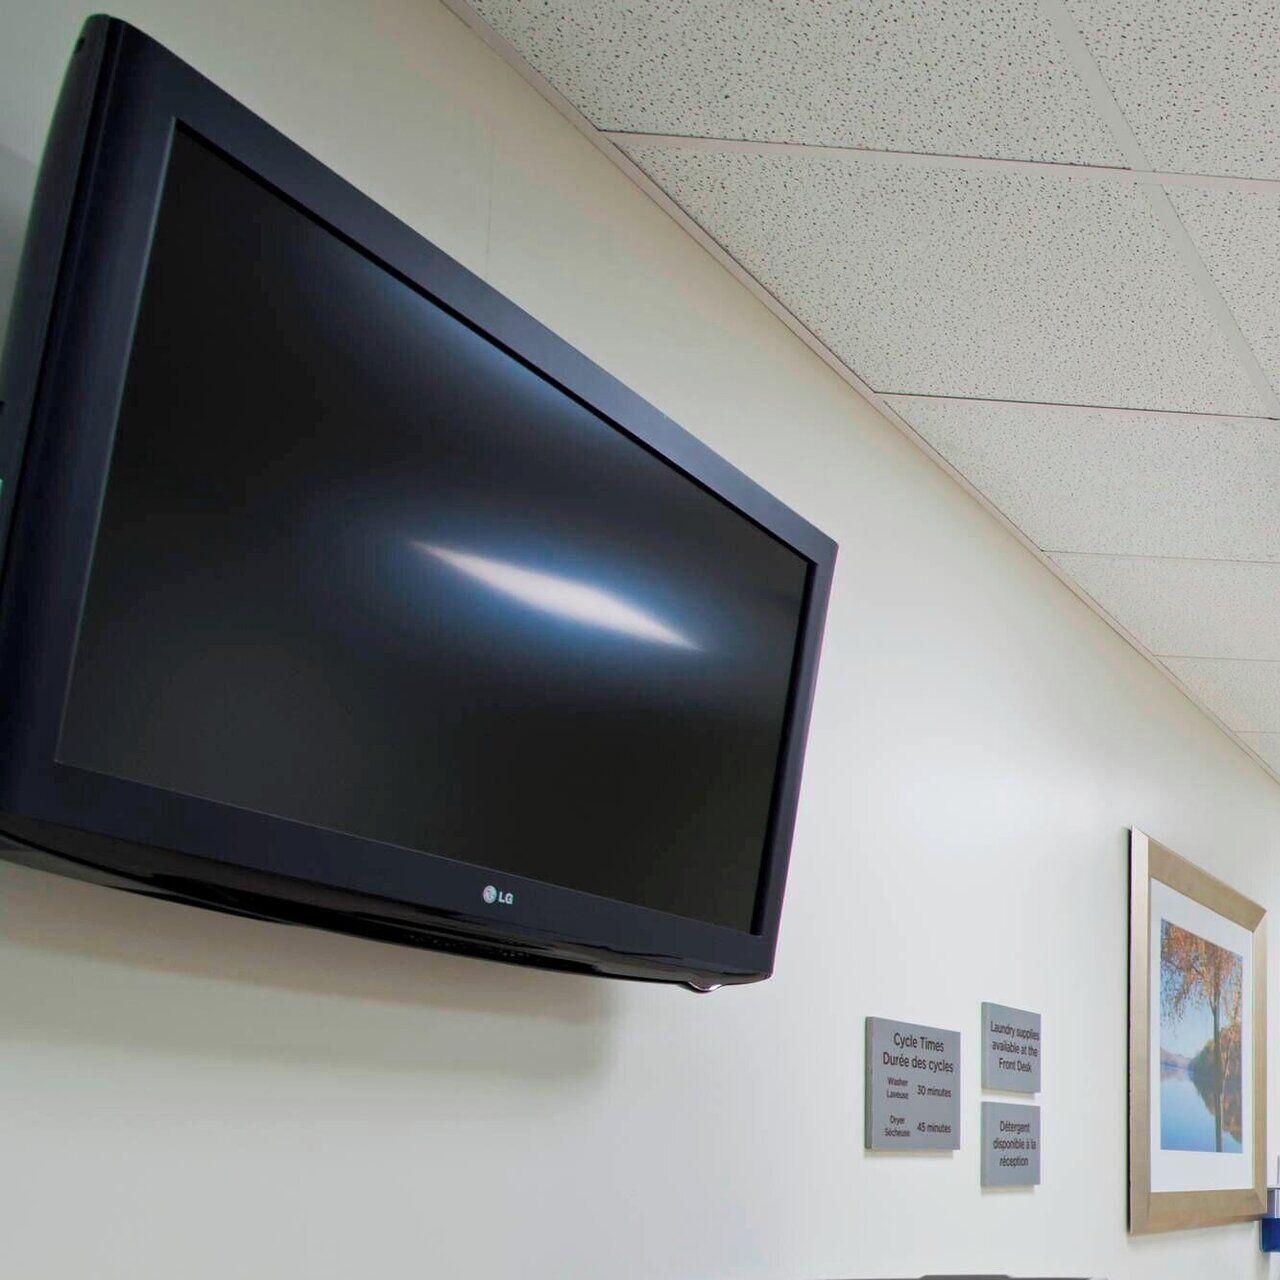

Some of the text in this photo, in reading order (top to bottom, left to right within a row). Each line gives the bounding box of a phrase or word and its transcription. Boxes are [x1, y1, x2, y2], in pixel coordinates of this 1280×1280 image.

[498, 891, 514, 905] LG
[990, 1020, 1040, 1042] Laundry supplies
[893, 1032, 944, 1052] Cycle Times
[992, 1039, 1038, 1057] available at the
[883, 1051, 953, 1073] Durée des cycles
[998, 1058, 1032, 1073] Front Desk
[887, 1076, 908, 1087] Washer
[917, 1084, 952, 1098] 30 minutes
[889, 1114, 906, 1126] Dryer
[917, 1121, 952, 1134] 45 minutes
[999, 1120, 1030, 1135] Détergent
[992, 1136, 1025, 1151] disponible
[999, 1153, 1029, 1168] réception
